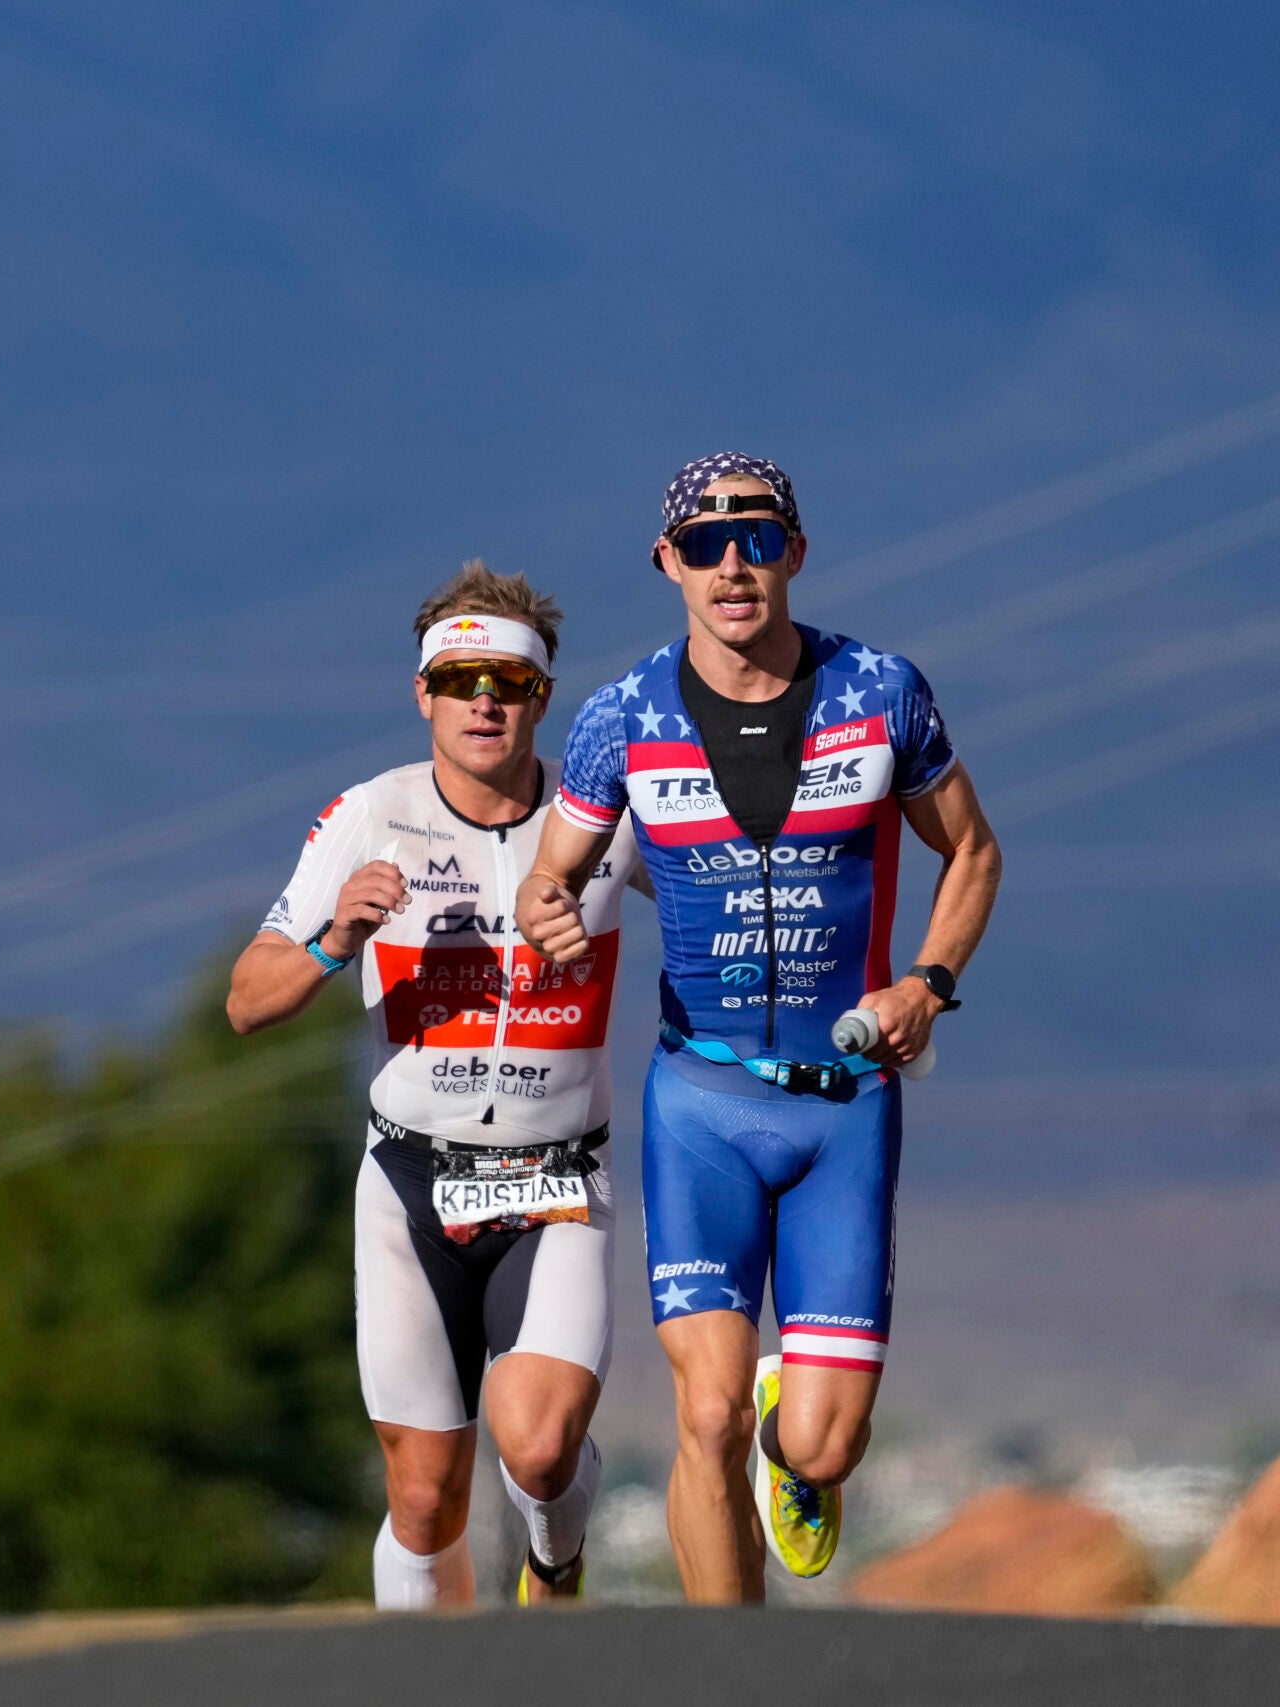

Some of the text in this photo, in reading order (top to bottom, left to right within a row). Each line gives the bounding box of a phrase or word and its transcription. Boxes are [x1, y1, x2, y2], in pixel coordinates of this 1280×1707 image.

[440, 634, 490, 647] Red Bull
[740, 726, 768, 735] Santini
[814, 722, 868, 752] Santini
[798, 780, 863, 801] RACING
[388, 820, 456, 842] SANTARA TECH
[687, 842, 844, 873] deboer
[782, 865, 839, 877] wetsuits
[409, 879, 480, 894] MAURTEN
[724, 886, 823, 914] HOKA
[742, 913, 807, 925] TIME TO FLY
[413, 962, 566, 979] BAHRAIN
[777, 959, 838, 973] Master
[415, 977, 563, 992] VICTORIOUS
[777, 972, 816, 989] Spas
[747, 994, 818, 1005] RUDY
[460, 1005, 582, 1025] TEXACO
[432, 1056, 551, 1081] deboer
[432, 1077, 547, 1099] wetsuits
[441, 1176, 579, 1214] KRISTIAN
[653, 1259, 727, 1282] Santini
[785, 1313, 875, 1328] BONTRAGER
